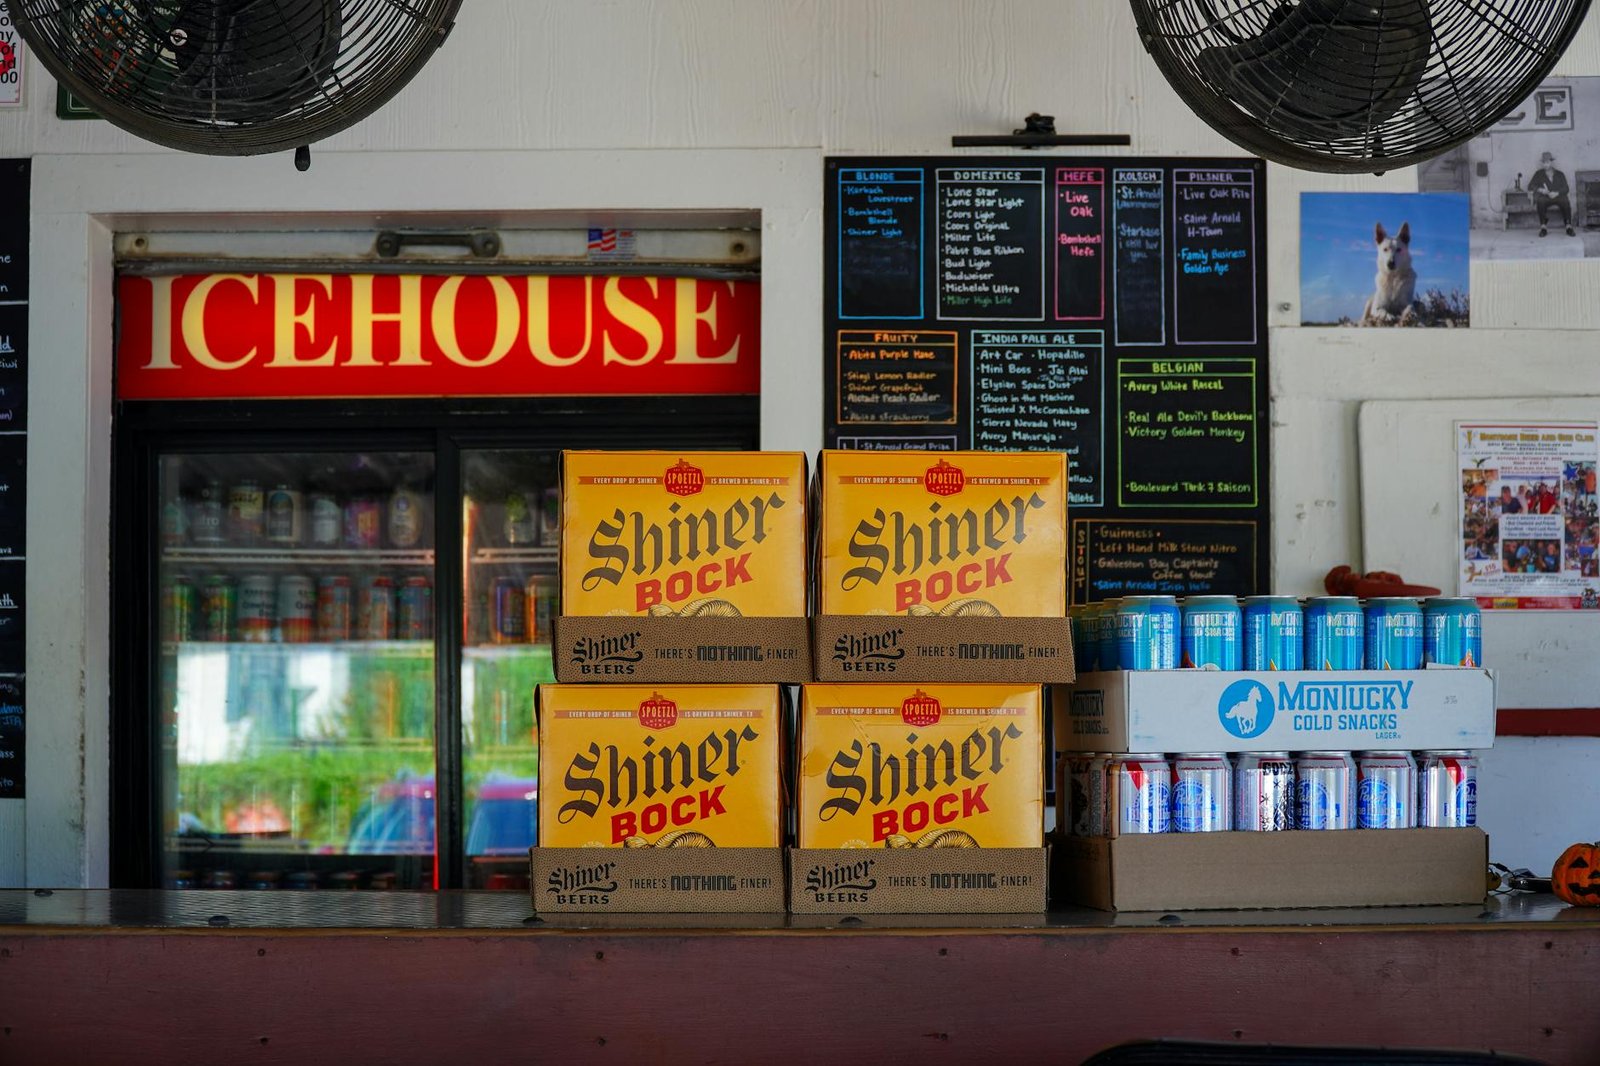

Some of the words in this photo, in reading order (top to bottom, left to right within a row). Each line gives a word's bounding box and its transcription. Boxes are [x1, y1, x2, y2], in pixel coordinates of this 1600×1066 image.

[855, 172, 895, 181] BLONDE
[954, 171, 1022, 181] DOMESTICS
[1064, 172, 1095, 181] HEFE
[1119, 172, 1157, 181] KOLSCH
[1189, 173, 1234, 182] PILSNER
[946, 187, 972, 197] Lone
[976, 187, 999, 196] Star
[1065, 191, 1089, 203] Live
[1183, 189, 1205, 199] Live
[1209, 188, 1229, 198] Oak
[945, 198, 972, 207] Lone
[974, 198, 997, 207] Star
[998, 198, 1025, 210] Light
[946, 210, 972, 219] Coors
[975, 211, 996, 223] Light
[1071, 206, 1094, 217] Oak
[1184, 212, 1207, 224] Saint
[1211, 212, 1241, 224] Arnold
[945, 222, 970, 231] Coors
[1187, 227, 1223, 237] H-Town
[945, 233, 972, 242] Miller
[945, 245, 970, 255] Pabst
[973, 246, 992, 255] Blue
[994, 245, 1025, 255] Ribbon
[1071, 246, 1095, 257] Hefe
[1181, 249, 1208, 264] Family
[1212, 249, 1247, 259] Business
[945, 258, 965, 268] Bud
[968, 259, 992, 270] Light
[1183, 263, 1212, 274] Golden
[1214, 263, 1229, 275] Age
[945, 271, 995, 280] Budweiser
[945, 283, 990, 293] Michelob
[992, 284, 1020, 294] Ultra
[141, 274, 741, 370] ICEHOUSE
[982, 334, 1018, 344] INDIA
[1021, 334, 1047, 344] PALE
[1053, 334, 1076, 344] ALE
[980, 350, 1002, 360] Art
[1005, 350, 1024, 360] Car
[1038, 349, 1085, 361] Hopadillo
[980, 363, 1003, 374] Mini
[1008, 364, 1032, 374] Boss
[1152, 362, 1204, 373] BELGIAN
[981, 378, 1016, 391] Elysian
[1021, 380, 1047, 390] Space
[1048, 380, 1071, 389] Dust
[1128, 381, 1158, 394] Avery
[1161, 380, 1188, 391] White
[981, 393, 1008, 403] Ghost
[1011, 395, 1020, 403] in
[1040, 392, 1075, 402] Machine
[980, 404, 1015, 414] Twisted
[1019, 406, 1026, 414] X
[1128, 411, 1150, 423] Real
[1157, 412, 1173, 422] Ale
[1212, 410, 1253, 421] Backbone
[982, 418, 1011, 428] Sierra
[1014, 419, 1049, 428] Nevada
[980, 431, 1008, 442] Avery
[1012, 431, 1057, 442] Maharaja
[1128, 427, 1167, 440] Victory
[1171, 426, 1205, 437] Golden
[1210, 427, 1245, 442] Monkey
[667, 472, 702, 485] SPOETZL
[928, 473, 962, 485] SPOETZL
[1130, 482, 1179, 492] Boulevard
[1217, 482, 1251, 492] Saison
[1101, 526, 1153, 538] Guinness
[581, 491, 786, 592] Shiner
[841, 491, 1046, 592] Shiner
[635, 552, 753, 612] BOCK
[895, 552, 1013, 612] BOCK
[570, 631, 643, 663] Shiner
[832, 628, 905, 660] Shiner
[655, 648, 693, 659] THERE'S
[697, 646, 763, 661] NOTHING
[767, 648, 798, 659] FINER!
[916, 646, 955, 657] THERE'S
[959, 644, 1025, 660] NOTHING
[1028, 646, 1060, 657] FINER!
[581, 664, 635, 674] BEERS
[843, 662, 896, 672] BEERS
[1278, 680, 1414, 710] MONTUCKY
[641, 706, 675, 717] SPOETZL
[904, 703, 939, 715] SPOETZL
[1293, 714, 1332, 731] COLD
[1338, 714, 1397, 730] SNACKS
[557, 724, 759, 825] Shiner
[818, 721, 1024, 821] Shiner
[611, 784, 727, 844] BOCK
[872, 783, 990, 842] BOCK
[546, 861, 618, 894] Shiner
[805, 859, 877, 892] Shiner
[888, 876, 926, 886] THERE'S
[930, 873, 997, 889] NOTHING
[1001, 876, 1032, 886] FINER!
[629, 877, 667, 888] THERE'S
[671, 875, 737, 891] NOTHING
[740, 878, 772, 888] FINER!
[556, 894, 610, 905] BEERS
[815, 893, 868, 903] BEERS
